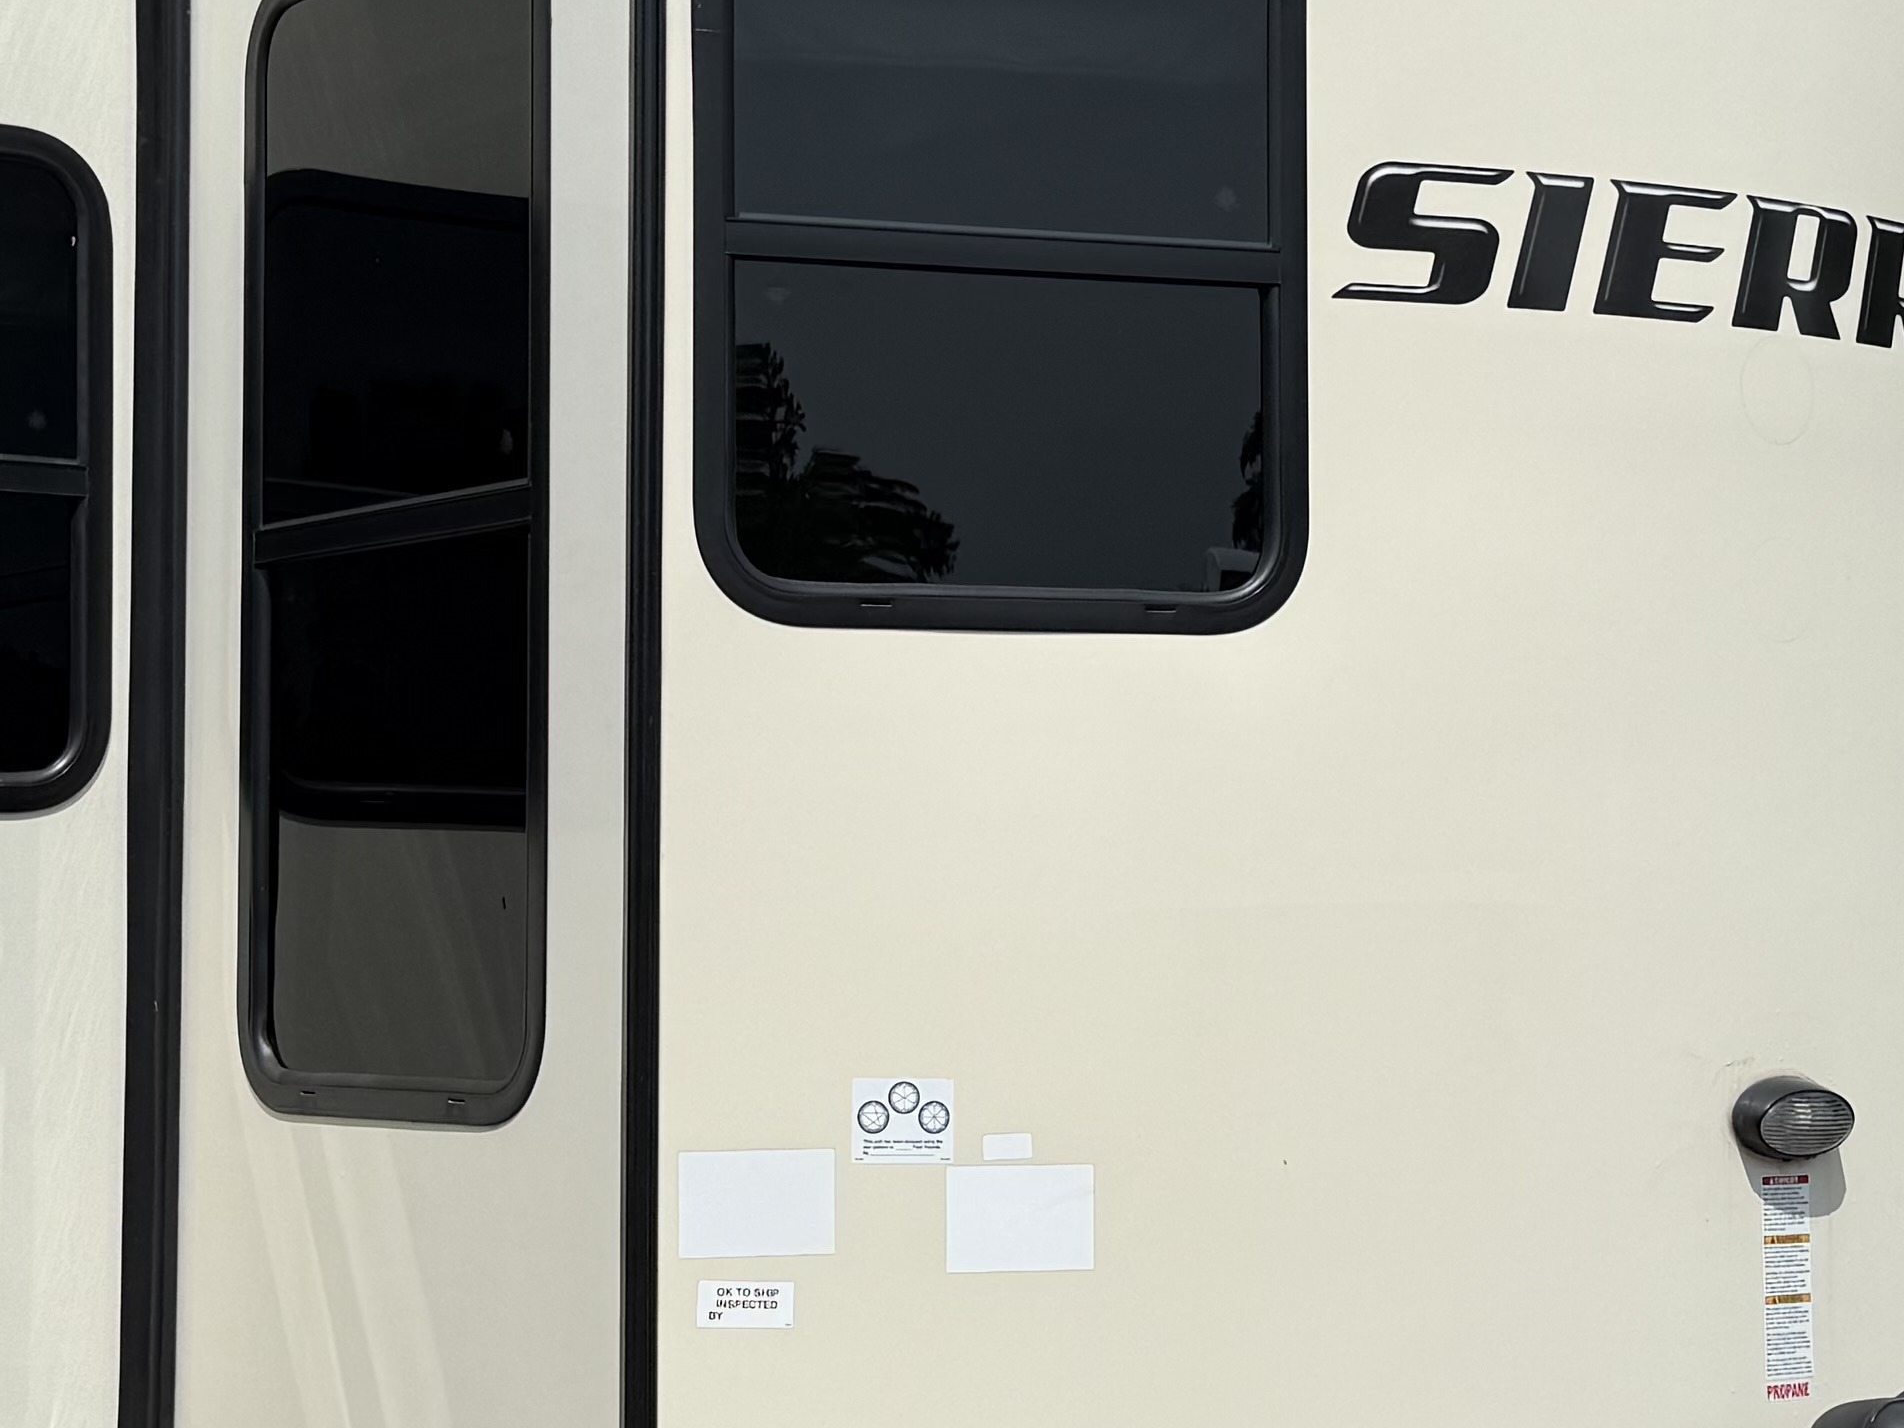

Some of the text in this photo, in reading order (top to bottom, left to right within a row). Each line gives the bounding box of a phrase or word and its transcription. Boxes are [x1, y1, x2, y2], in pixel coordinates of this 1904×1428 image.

[716, 1287, 733, 1297] OK
[736, 1287, 751, 1297] TO
[716, 1299, 778, 1309] INSPECTED
[1767, 1382, 1810, 1400] PROPANE
